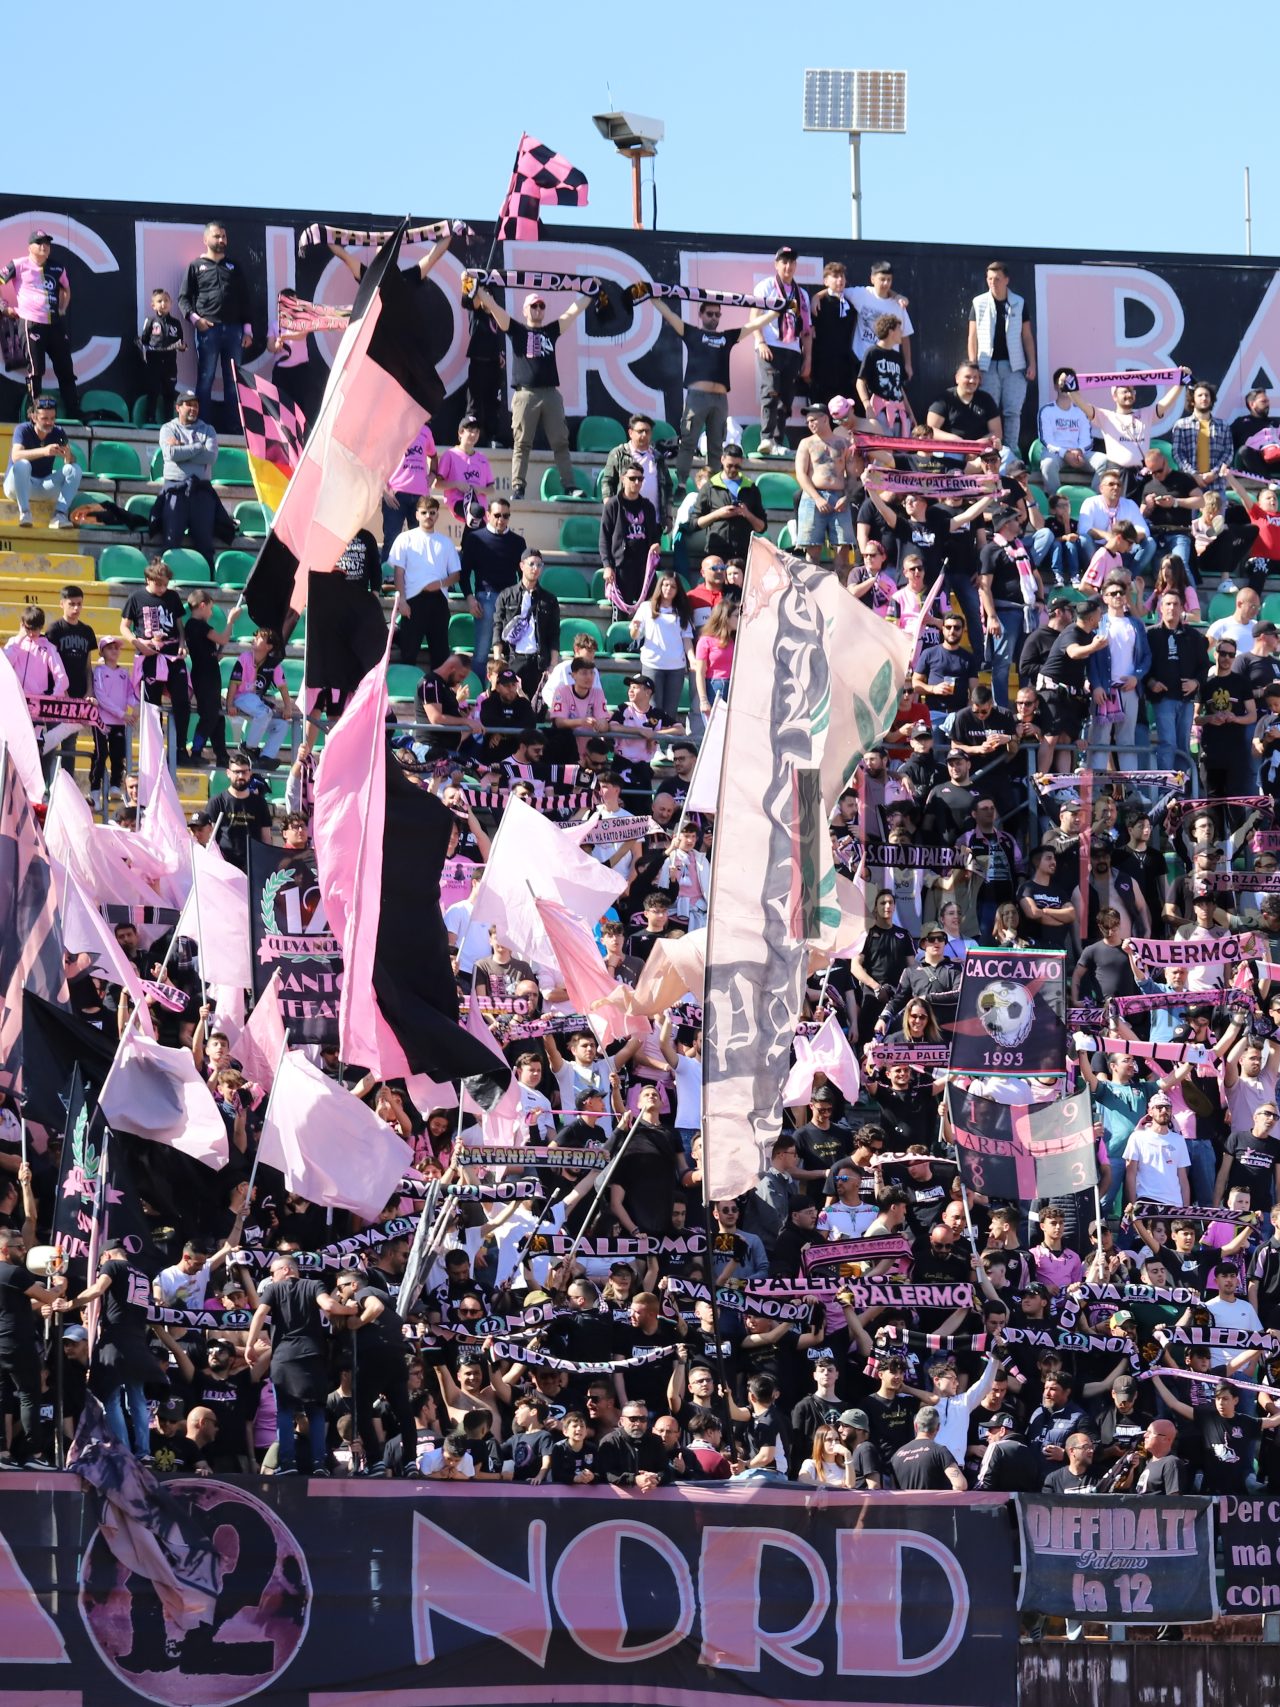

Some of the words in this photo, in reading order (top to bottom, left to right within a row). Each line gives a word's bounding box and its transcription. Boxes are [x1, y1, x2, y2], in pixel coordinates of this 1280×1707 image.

[466, 268, 600, 297] PALERMO
[652, 283, 787, 310] PALERMO
[888, 474, 922, 486] FORZA
[60, 635, 89, 652] TOMMY
[42, 704, 99, 721] PALERMO
[612, 819, 630, 829] SONO
[604, 831, 619, 841] FATTO
[909, 845, 920, 866] DI
[1215, 874, 1260, 884] FORZA
[280, 886, 333, 935] 12
[269, 937, 310, 953] CURVA
[312, 939, 344, 954] NOR
[966, 959, 1062, 981] CACCAMO
[277, 972, 344, 994] ANT
[1068, 1009, 1105, 1022] ERM
[872, 1052, 912, 1061] FORZA
[983, 1051, 1024, 1066] 1993
[968, 1099, 978, 1124] 1
[1063, 1106, 1077, 1127] 9
[963, 1131, 1092, 1158] ARENELLA
[459, 1148, 536, 1165] CATANIA
[547, 1150, 609, 1169] MERDA
[972, 1164, 985, 1188] 8
[1072, 1162, 1087, 1187] 3
[324, 1229, 388, 1254] URVA
[552, 1234, 708, 1257] PALERMO
[126, 1273, 152, 1307] 12
[745, 1276, 889, 1292] PALERMO
[855, 1284, 972, 1307] PALERMO
[147, 1305, 218, 1327] URVA
[744, 1295, 810, 1320] NORD
[494, 1341, 577, 1371] CURVA
[1220, 1496, 1264, 1525] Per
[1027, 1505, 1199, 1552] DIFFIDATI
[1075, 1549, 1149, 1571] Palermo
[1232, 1542, 1272, 1567] ma
[411, 1510, 967, 1678] NORD
[1072, 1573, 1110, 1614] la
[1114, 1572, 1155, 1614] 12
